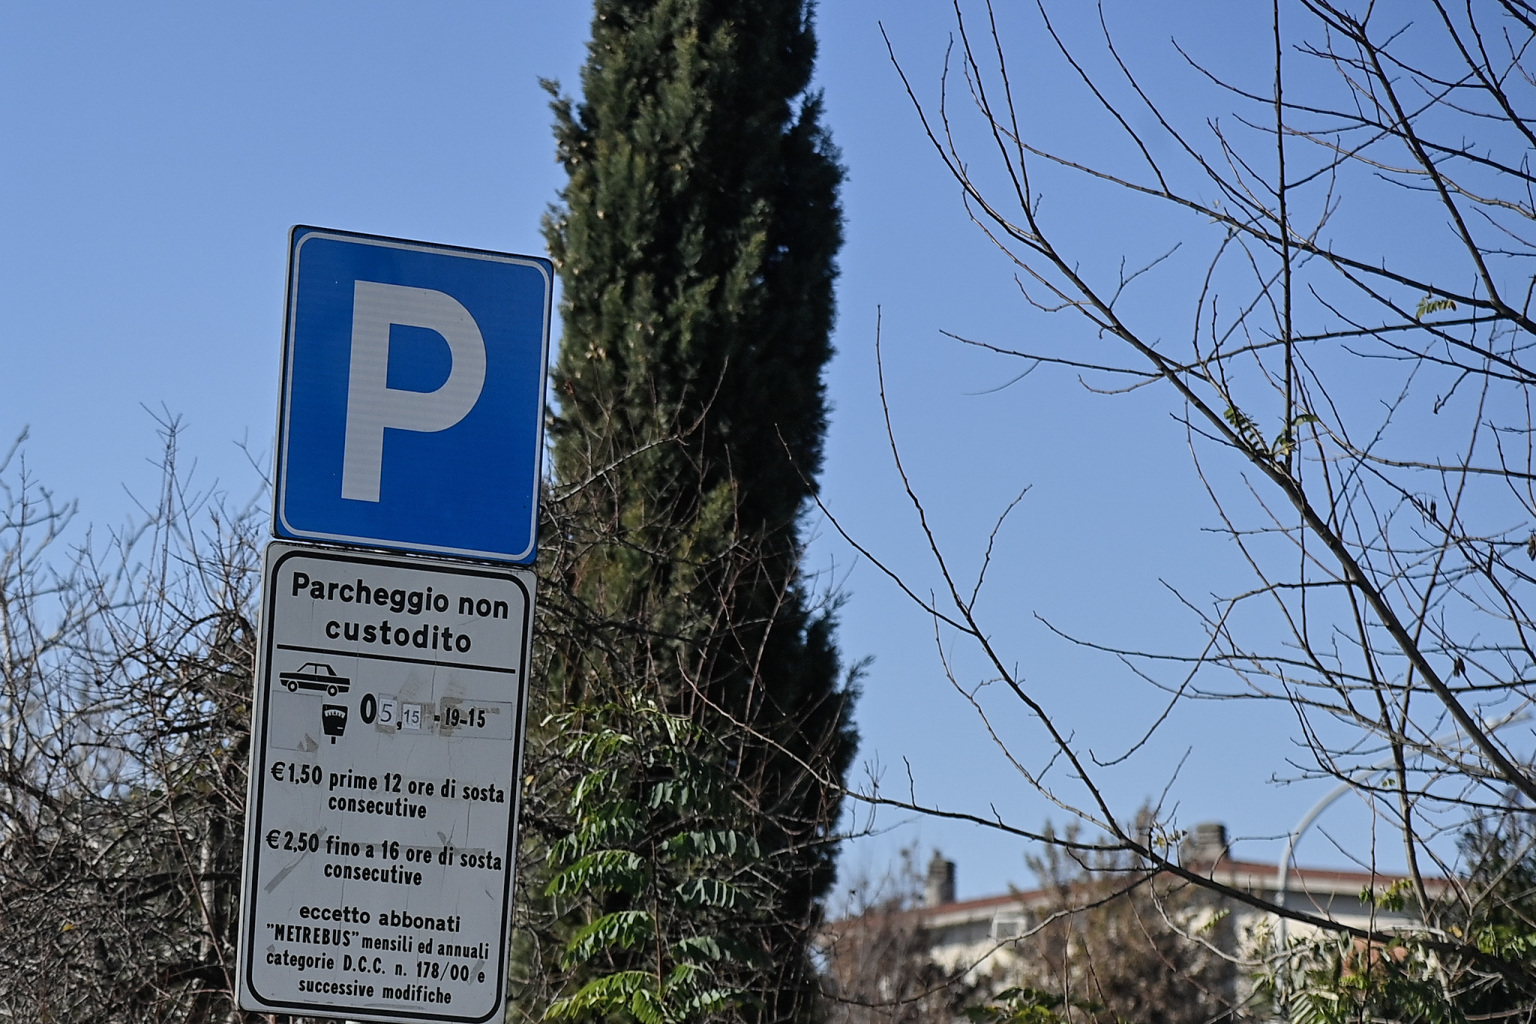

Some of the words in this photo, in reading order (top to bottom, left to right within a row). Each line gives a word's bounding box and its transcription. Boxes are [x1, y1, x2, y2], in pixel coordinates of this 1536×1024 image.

[342, 280, 486, 502] P
[292, 572, 449, 615] Parcheggio
[458, 596, 509, 619] non
[325, 620, 471, 653] custodito
[329, 769, 378, 792] prime
[383, 773, 403, 794] 12
[408, 779, 435, 797] ore
[440, 779, 456, 799] di
[462, 784, 505, 804] sosta
[328, 795, 428, 819] consecutive
[326, 835, 361, 857] fino
[365, 844, 375, 859] a
[381, 840, 400, 861] 16
[405, 847, 432, 864] ore
[438, 846, 454, 867] di
[460, 852, 503, 871] sosta
[323, 862, 423, 887] consecutive
[299, 905, 371, 925] eccetto
[378, 909, 461, 933] abbonati
[361, 934, 413, 953] mensili
[417, 938, 433, 955] ed
[437, 942, 490, 961] annuali
[266, 949, 335, 972] categorie
[343, 953, 386, 975] D.C.C.
[395, 963, 408, 978] n.
[416, 960, 470, 983] 178/00
[477, 971, 486, 983] e
[298, 978, 375, 998] successive
[381, 984, 452, 1005] modifiche
